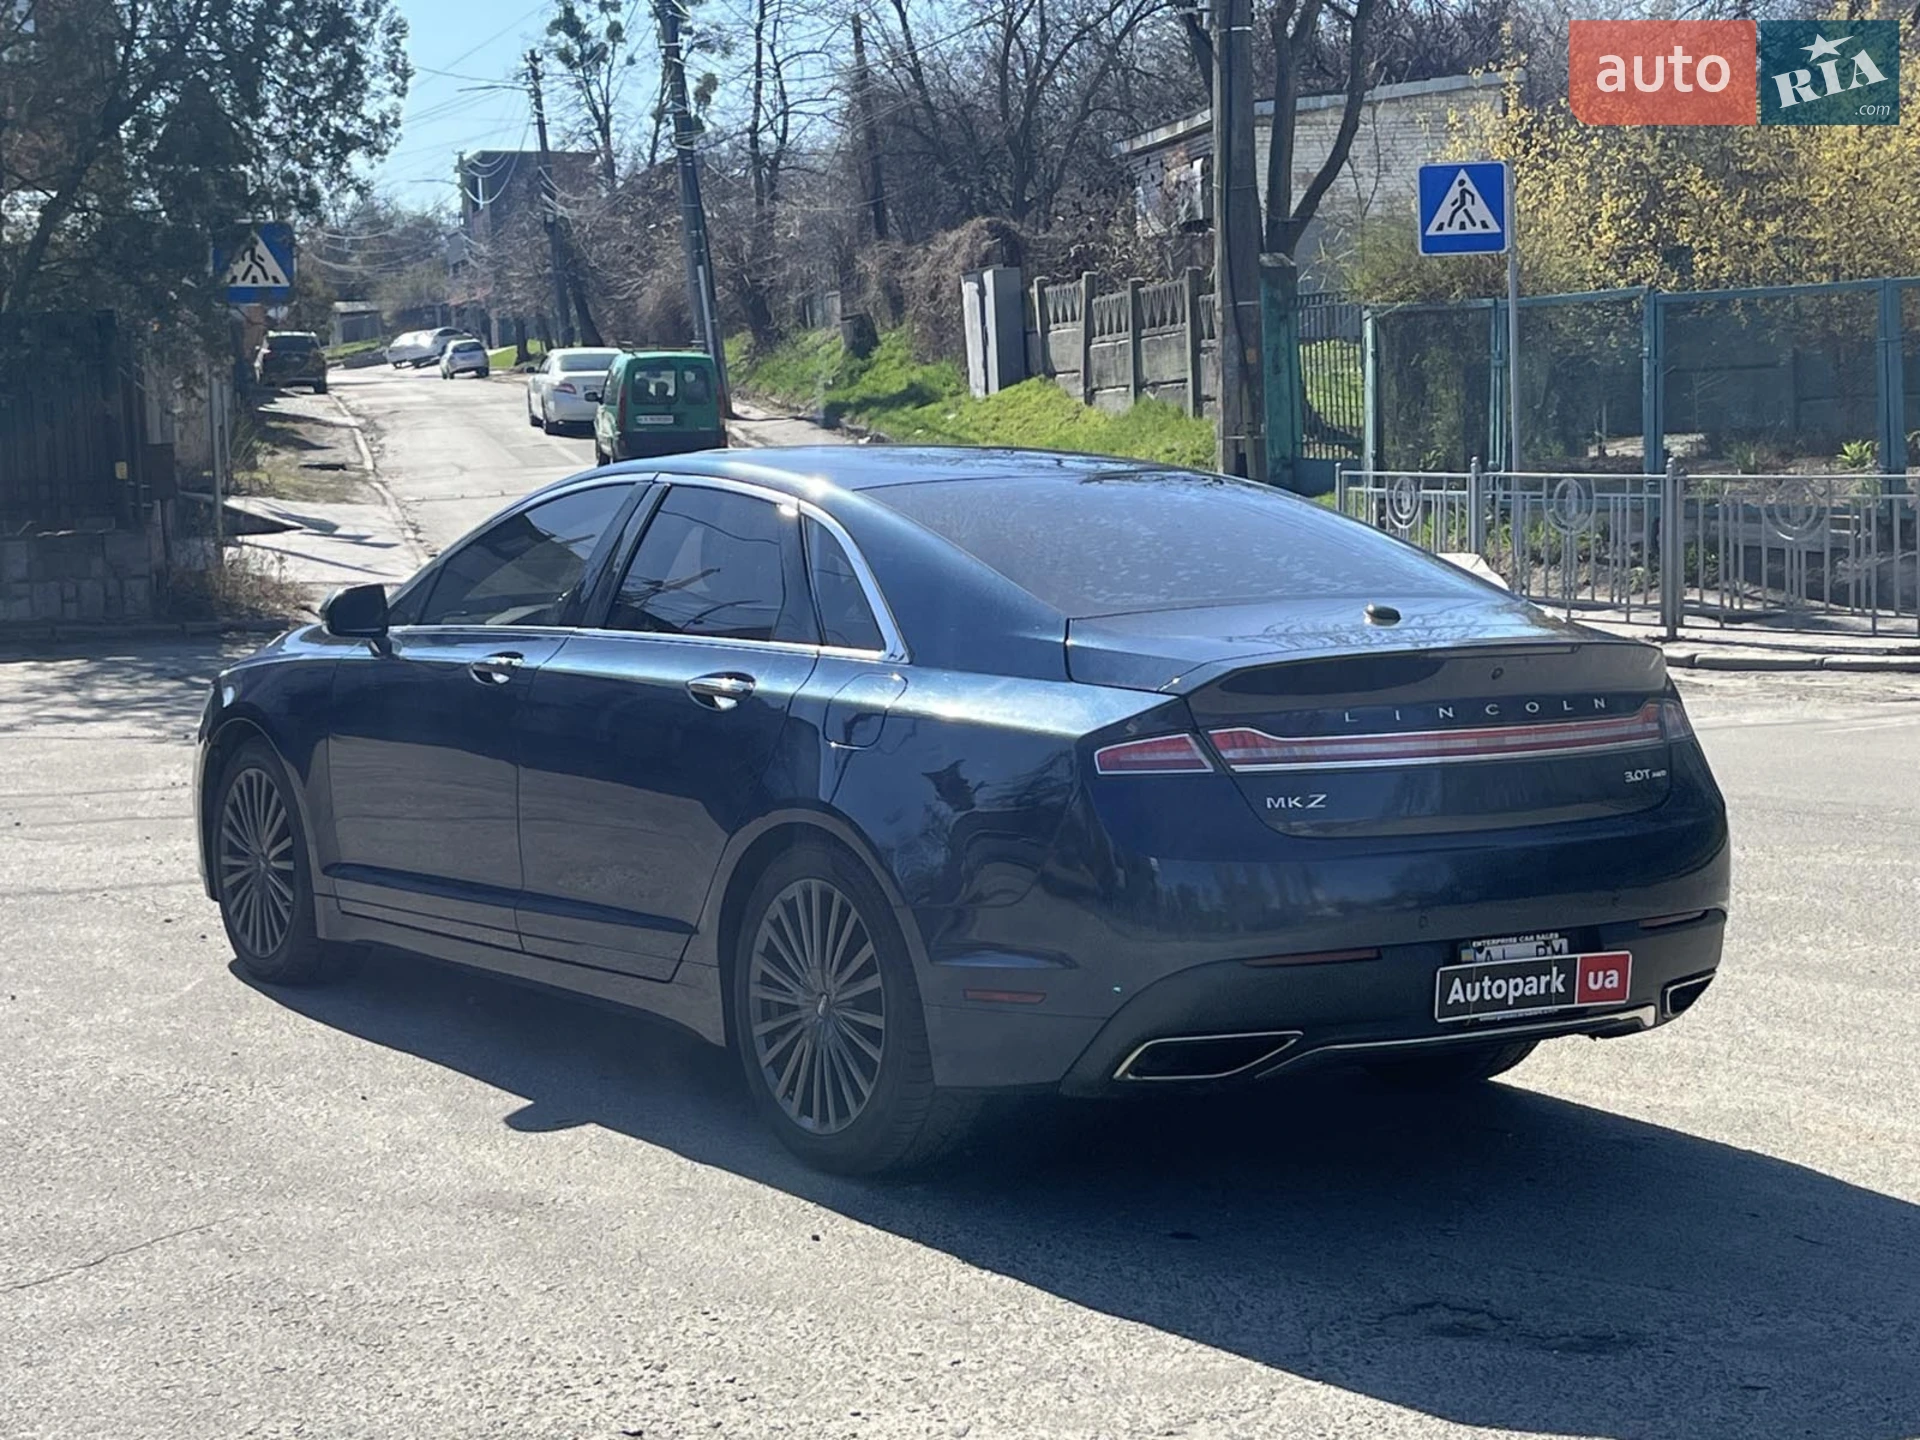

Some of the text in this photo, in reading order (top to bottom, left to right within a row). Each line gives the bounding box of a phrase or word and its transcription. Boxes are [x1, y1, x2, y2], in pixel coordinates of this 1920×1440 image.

[1344, 697, 1606, 723] LINCOLN
[1266, 794, 1327, 809] MKZ
[1472, 932, 1560, 948] ENTERPRISE CAR SALES
[1446, 966, 1619, 1006] Autopark ua
